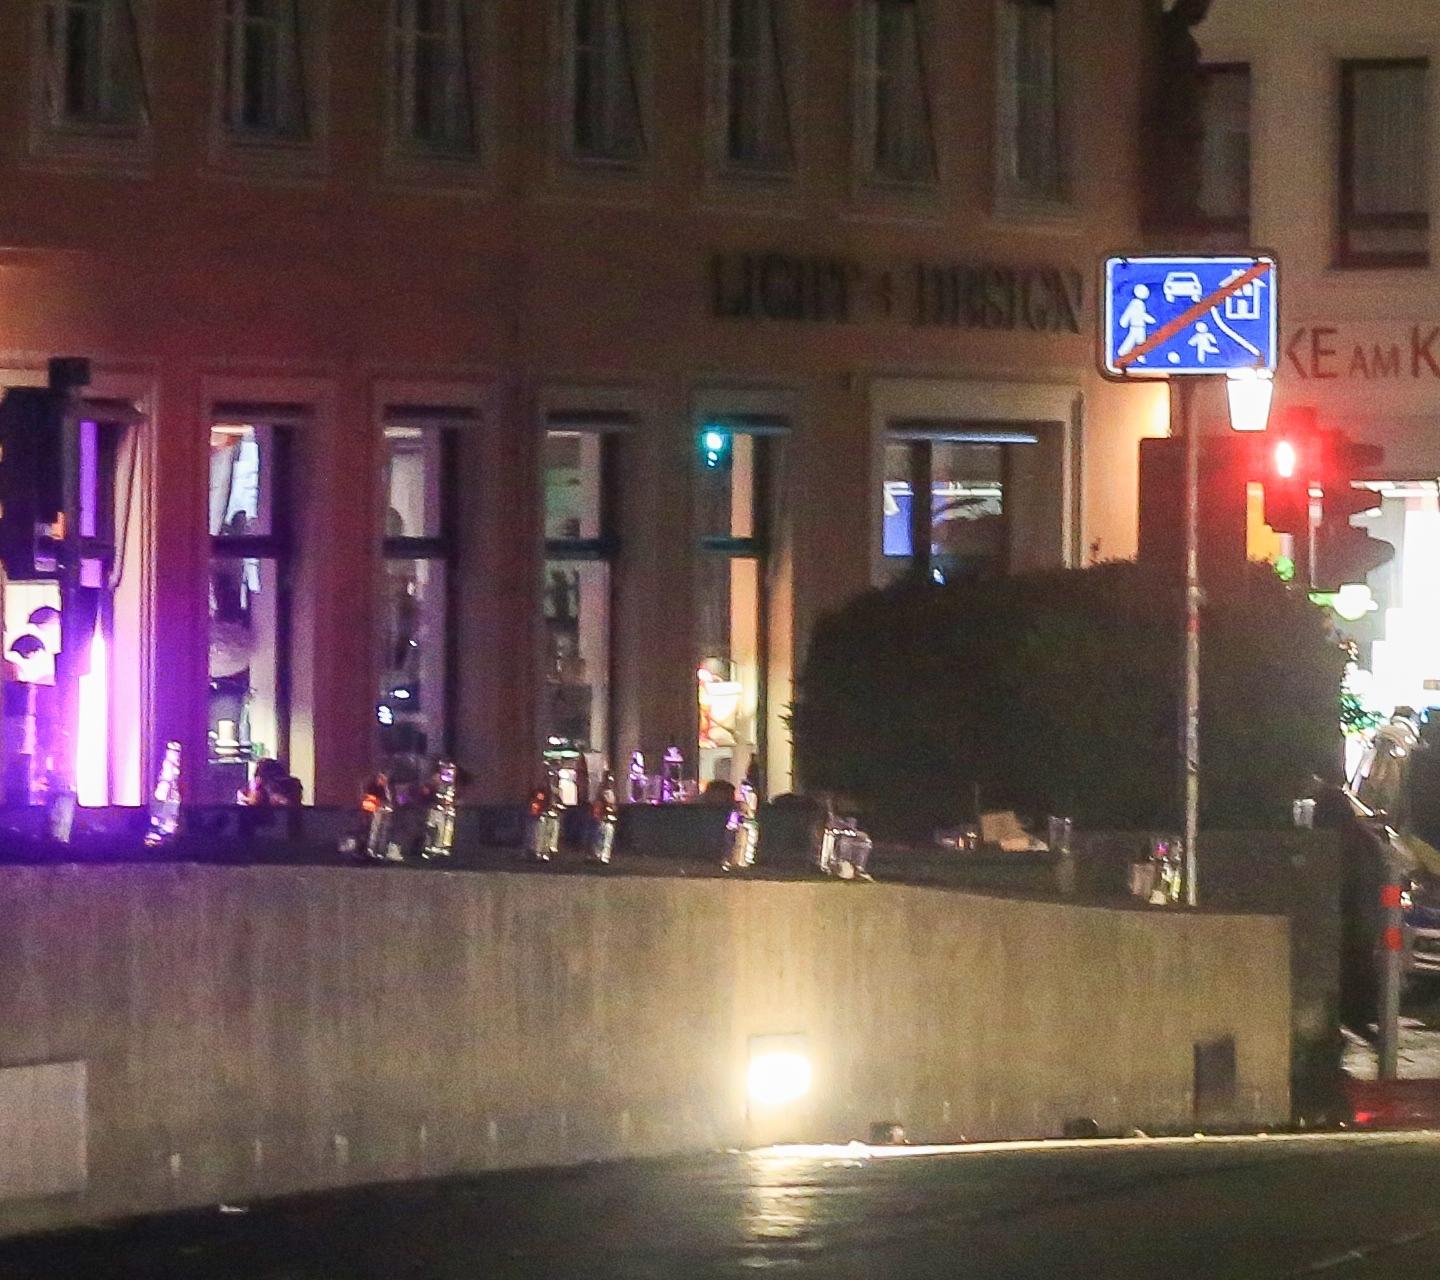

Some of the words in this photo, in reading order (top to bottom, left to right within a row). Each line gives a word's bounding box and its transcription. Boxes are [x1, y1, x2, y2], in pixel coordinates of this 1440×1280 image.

[710, 254, 858, 322] LIGHT
[915, 263, 1081, 334] DESIGN
[1348, 344, 1401, 379] AM
